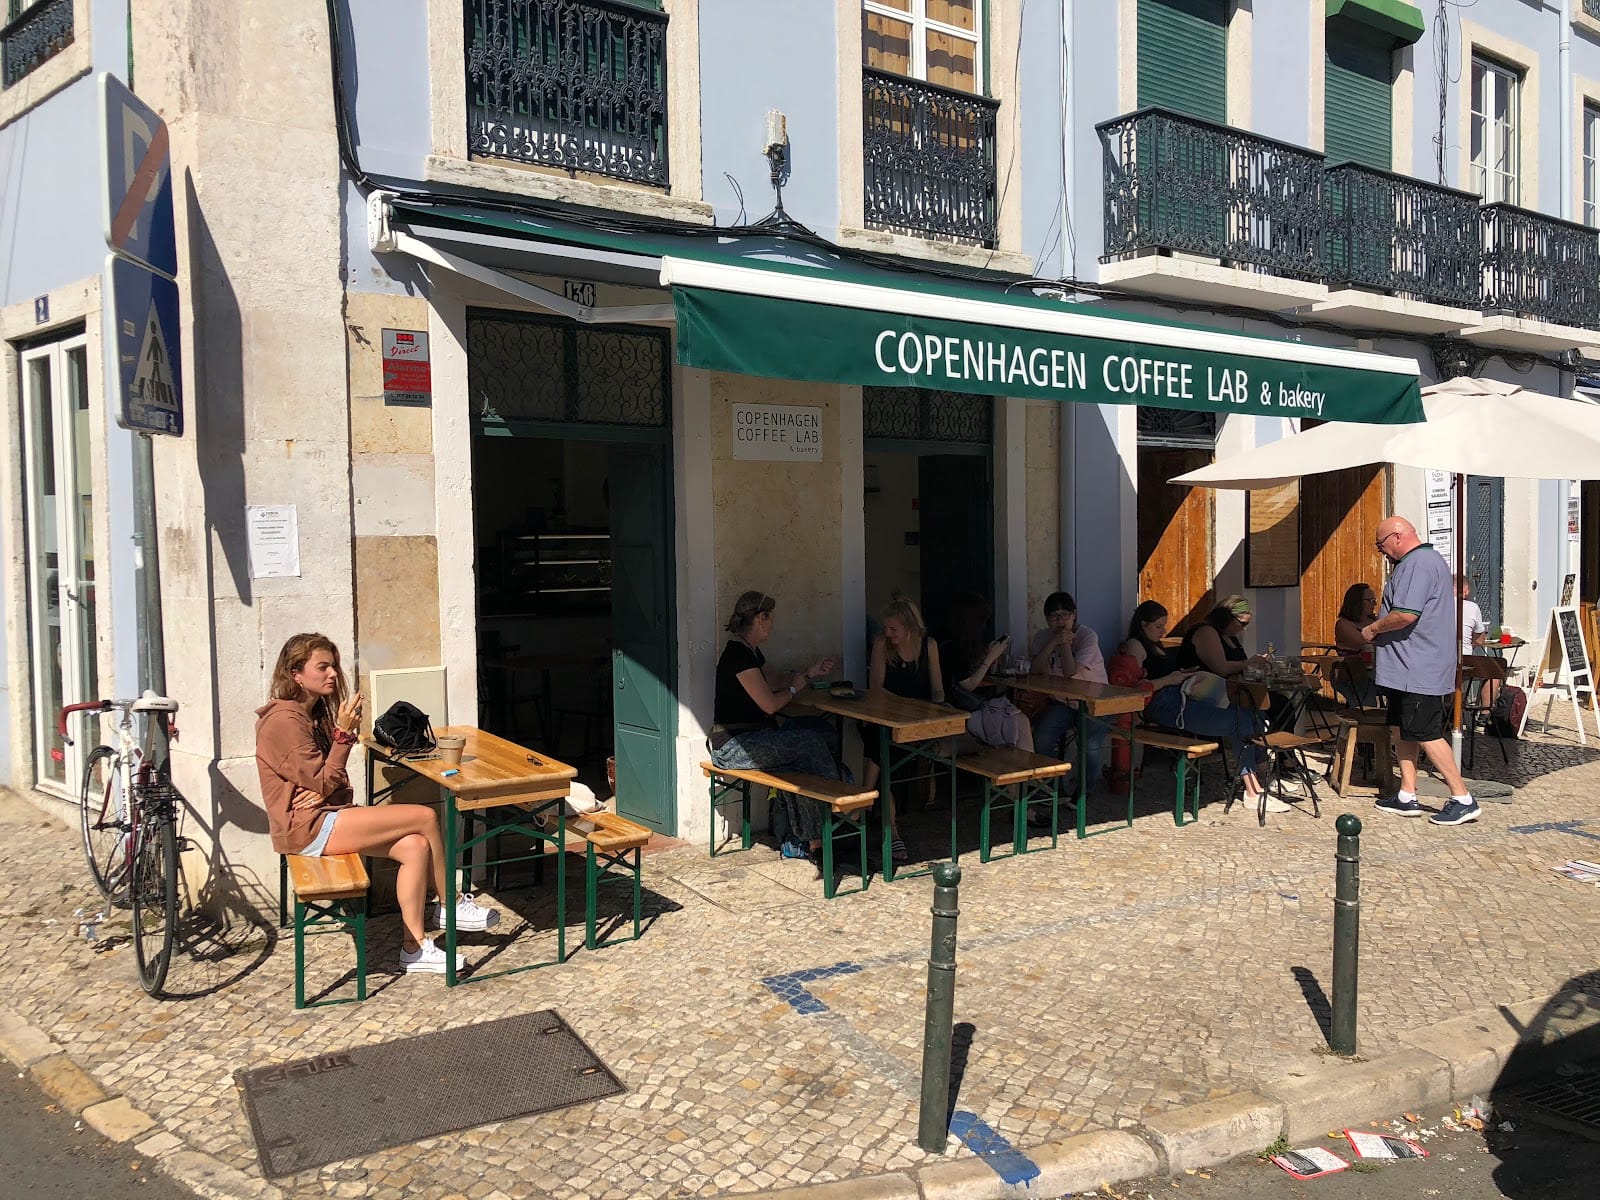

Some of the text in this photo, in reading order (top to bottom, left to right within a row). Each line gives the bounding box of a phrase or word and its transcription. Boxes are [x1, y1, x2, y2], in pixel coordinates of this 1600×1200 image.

[566, 282, 594, 306] 136
[390, 345, 420, 356] Direct
[874, 329, 1326, 416] COPENHAGEN COFFEE LAB & bakery
[736, 411, 818, 428] COPENHAGEN
[737, 428, 819, 443] COFFEE LAB
[797, 446, 818, 454] bakery
[262, 1057, 346, 1084] TLP
